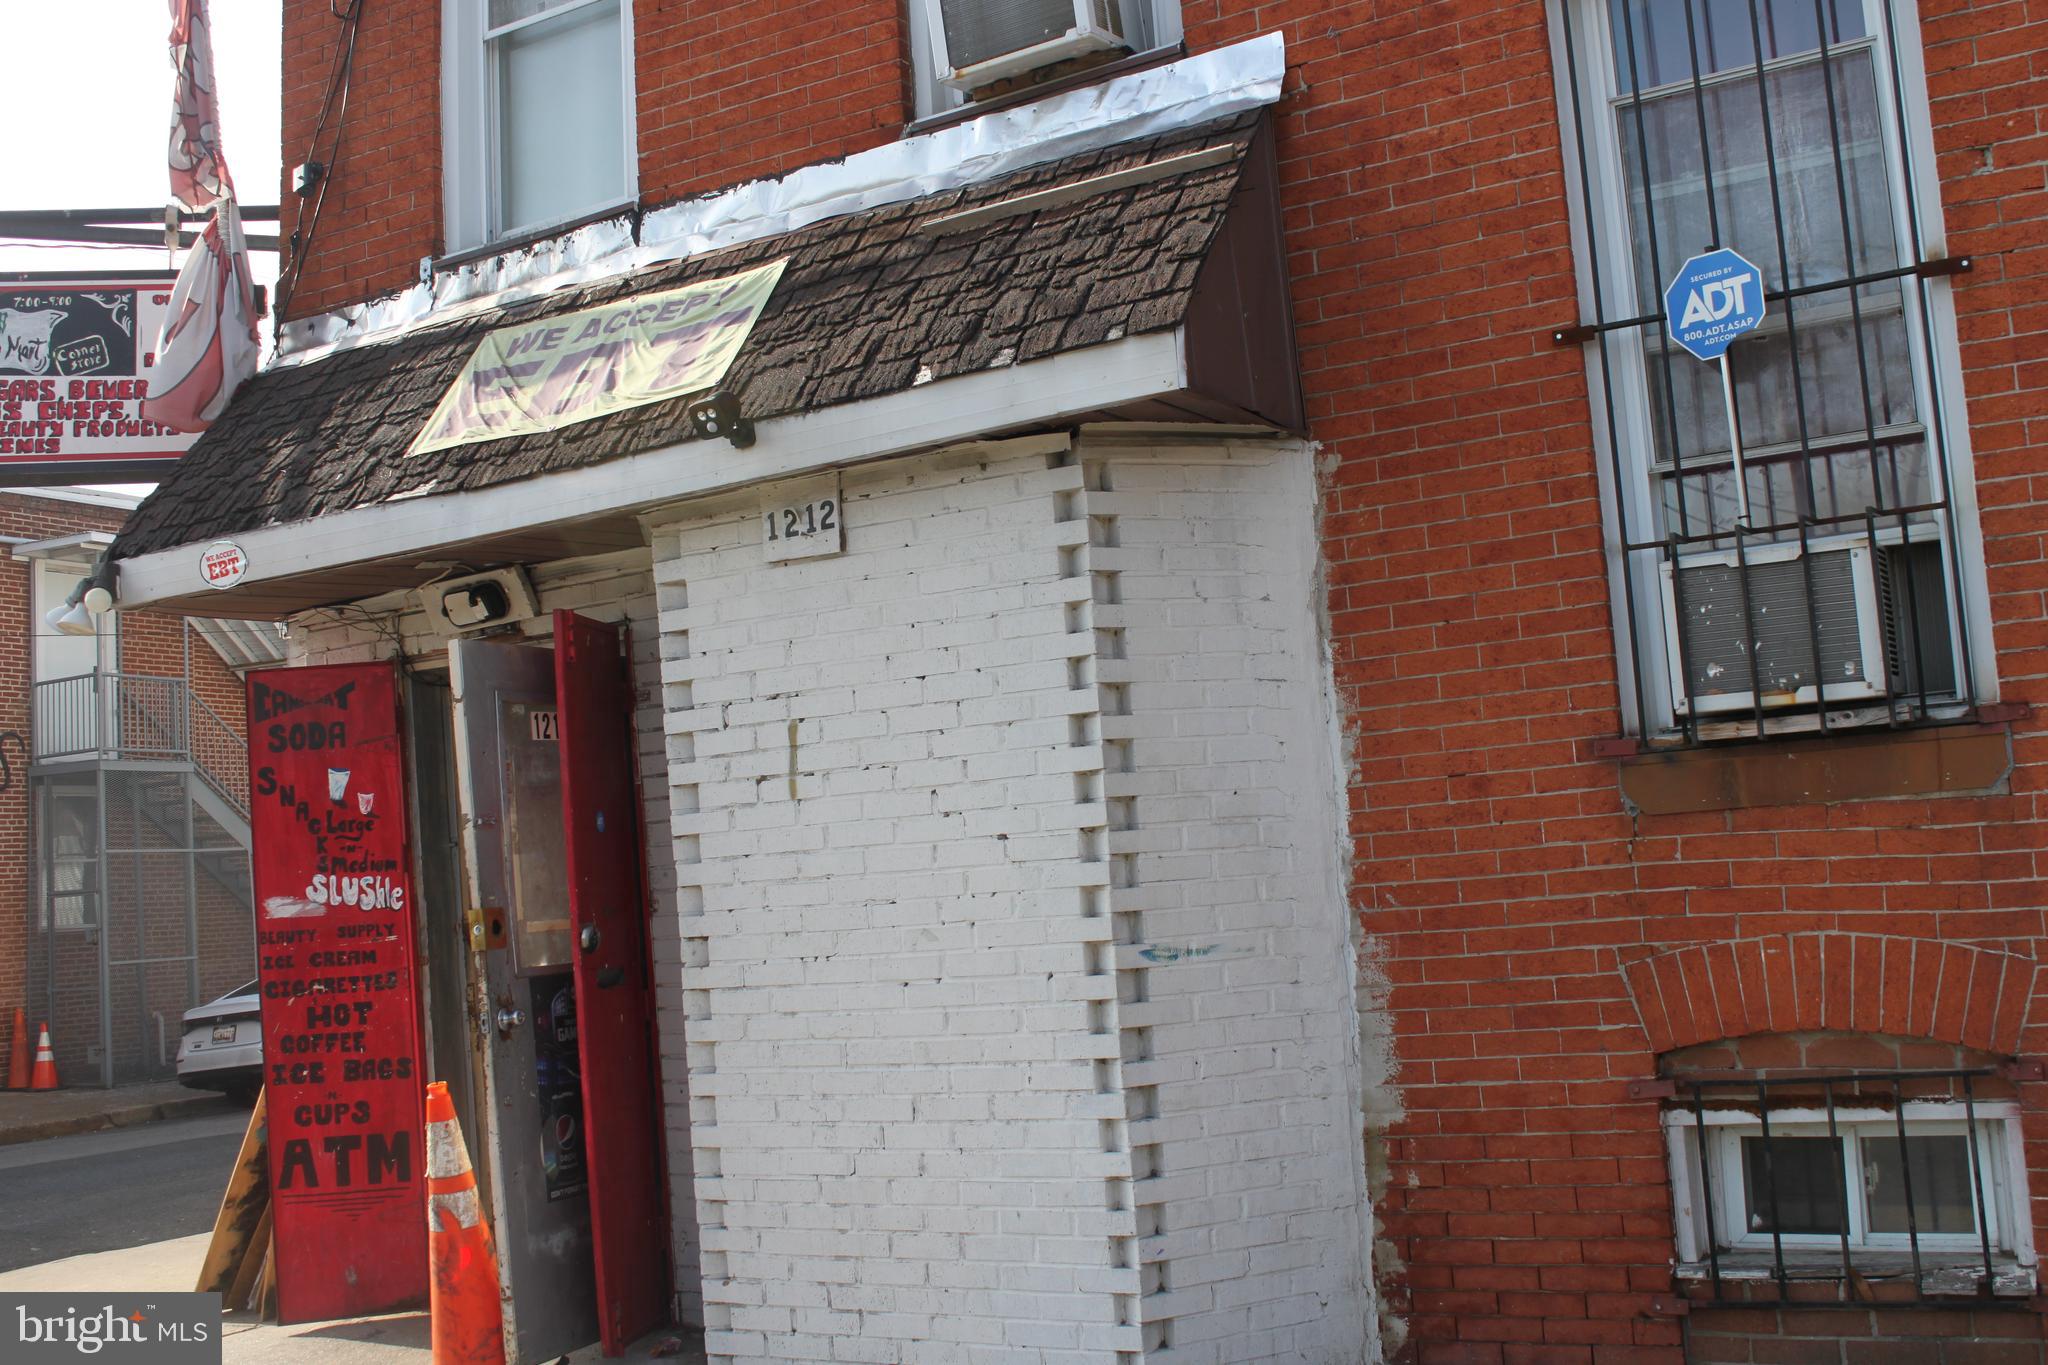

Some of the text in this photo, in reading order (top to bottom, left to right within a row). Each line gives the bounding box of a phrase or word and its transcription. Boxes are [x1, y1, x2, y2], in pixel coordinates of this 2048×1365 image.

[1690, 266, 1733, 283] SECURED BY
[1680, 273, 1751, 329] ADT
[505, 326, 569, 359] WE
[1684, 317, 1754, 341] 800.ADT.ASAP
[1704, 333, 1737, 346] ADT.COM
[767, 500, 835, 541] 1212
[205, 549, 237, 562] WE ACCEPT
[207, 556, 240, 581] EBT
[268, 721, 347, 753] SODA
[326, 809, 375, 841] Large
[337, 923, 395, 939] SUPPLY
[263, 950, 377, 970] ICE CREAM
[307, 1002, 373, 1029] HOT
[280, 1031, 366, 1054] COFFEE
[272, 1057, 413, 1086] ICE BAGS
[294, 1100, 371, 1127] CUPS
[278, 1130, 411, 1189] ATM
